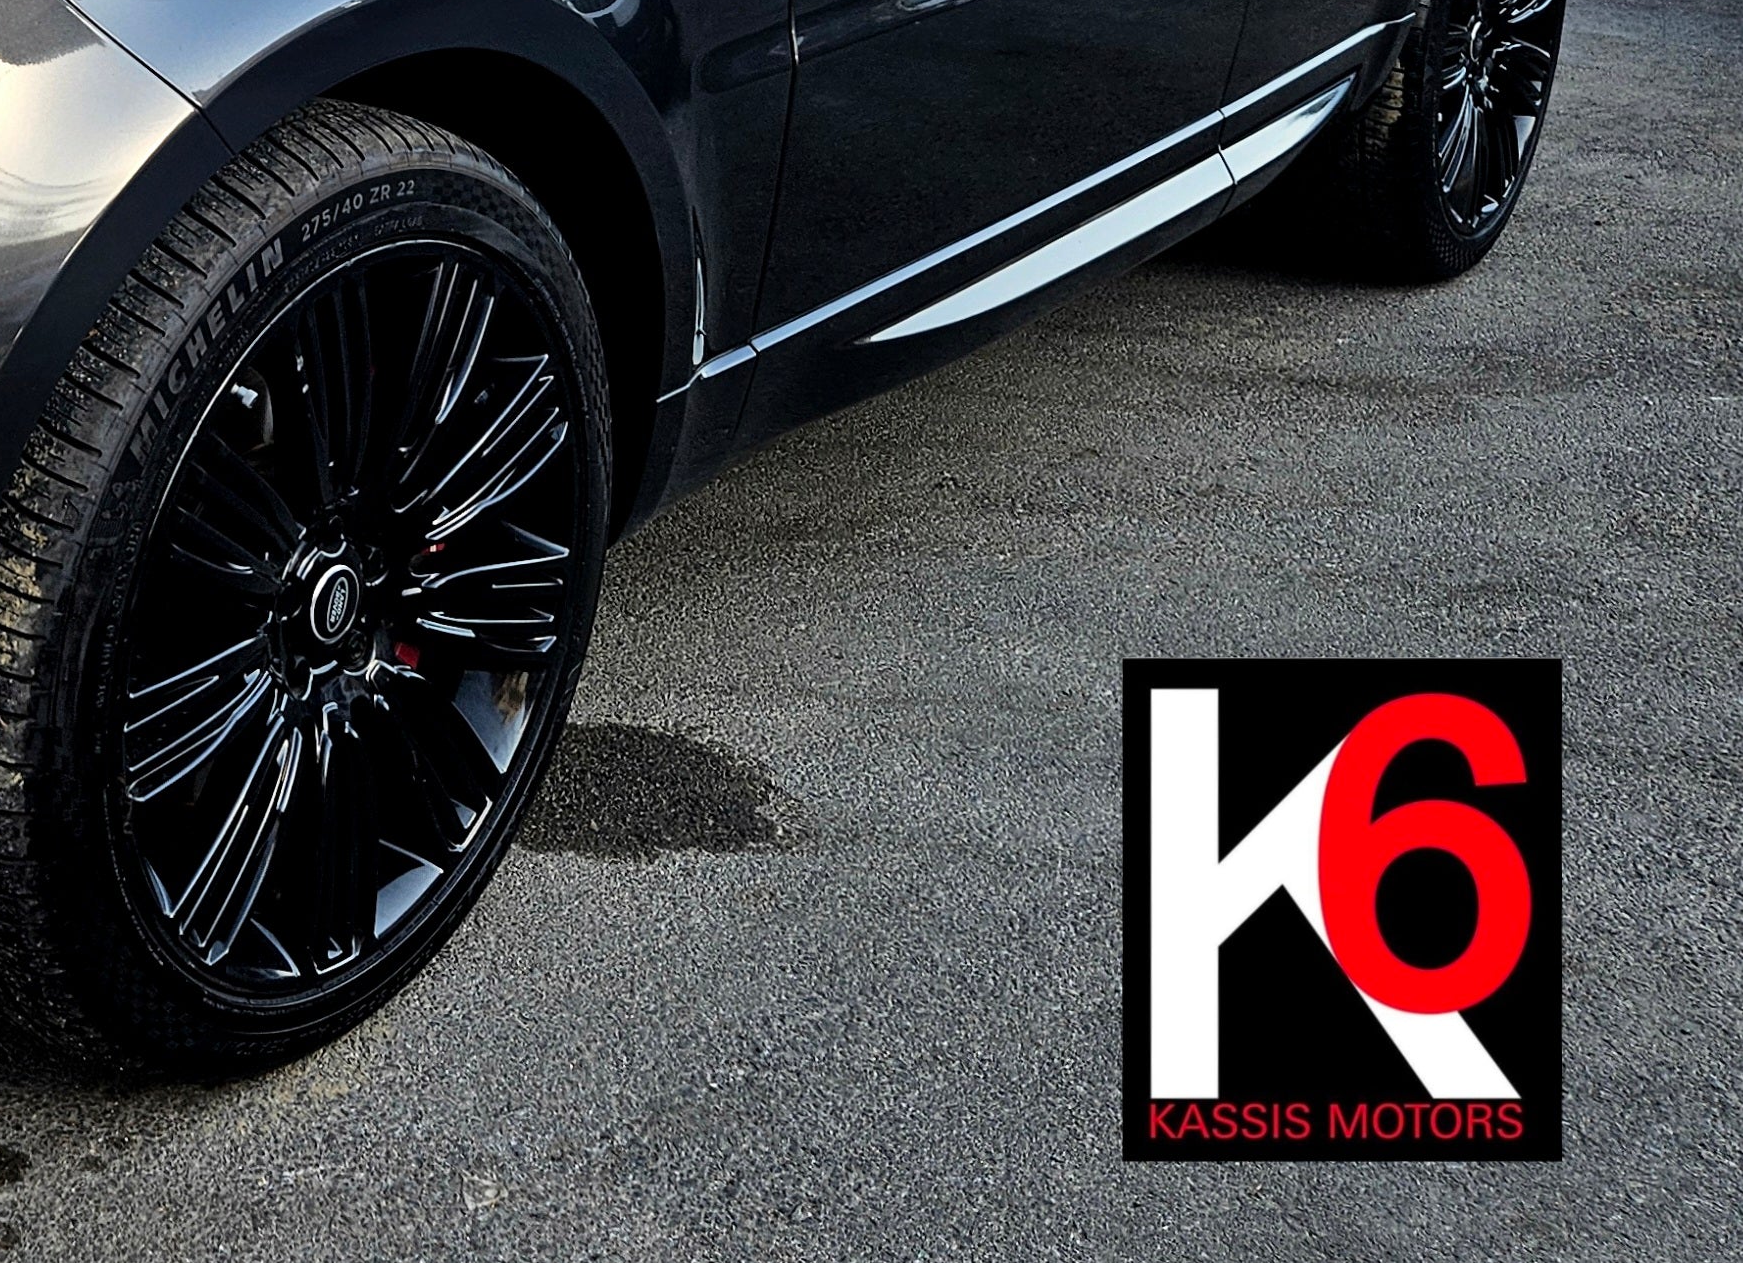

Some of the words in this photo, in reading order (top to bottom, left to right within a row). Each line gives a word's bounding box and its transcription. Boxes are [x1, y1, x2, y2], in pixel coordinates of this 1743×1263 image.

[301, 193, 364, 242] 275/40
[369, 184, 391, 205] ZR
[396, 180, 416, 196] 22
[127, 238, 285, 468] MICHELIN
